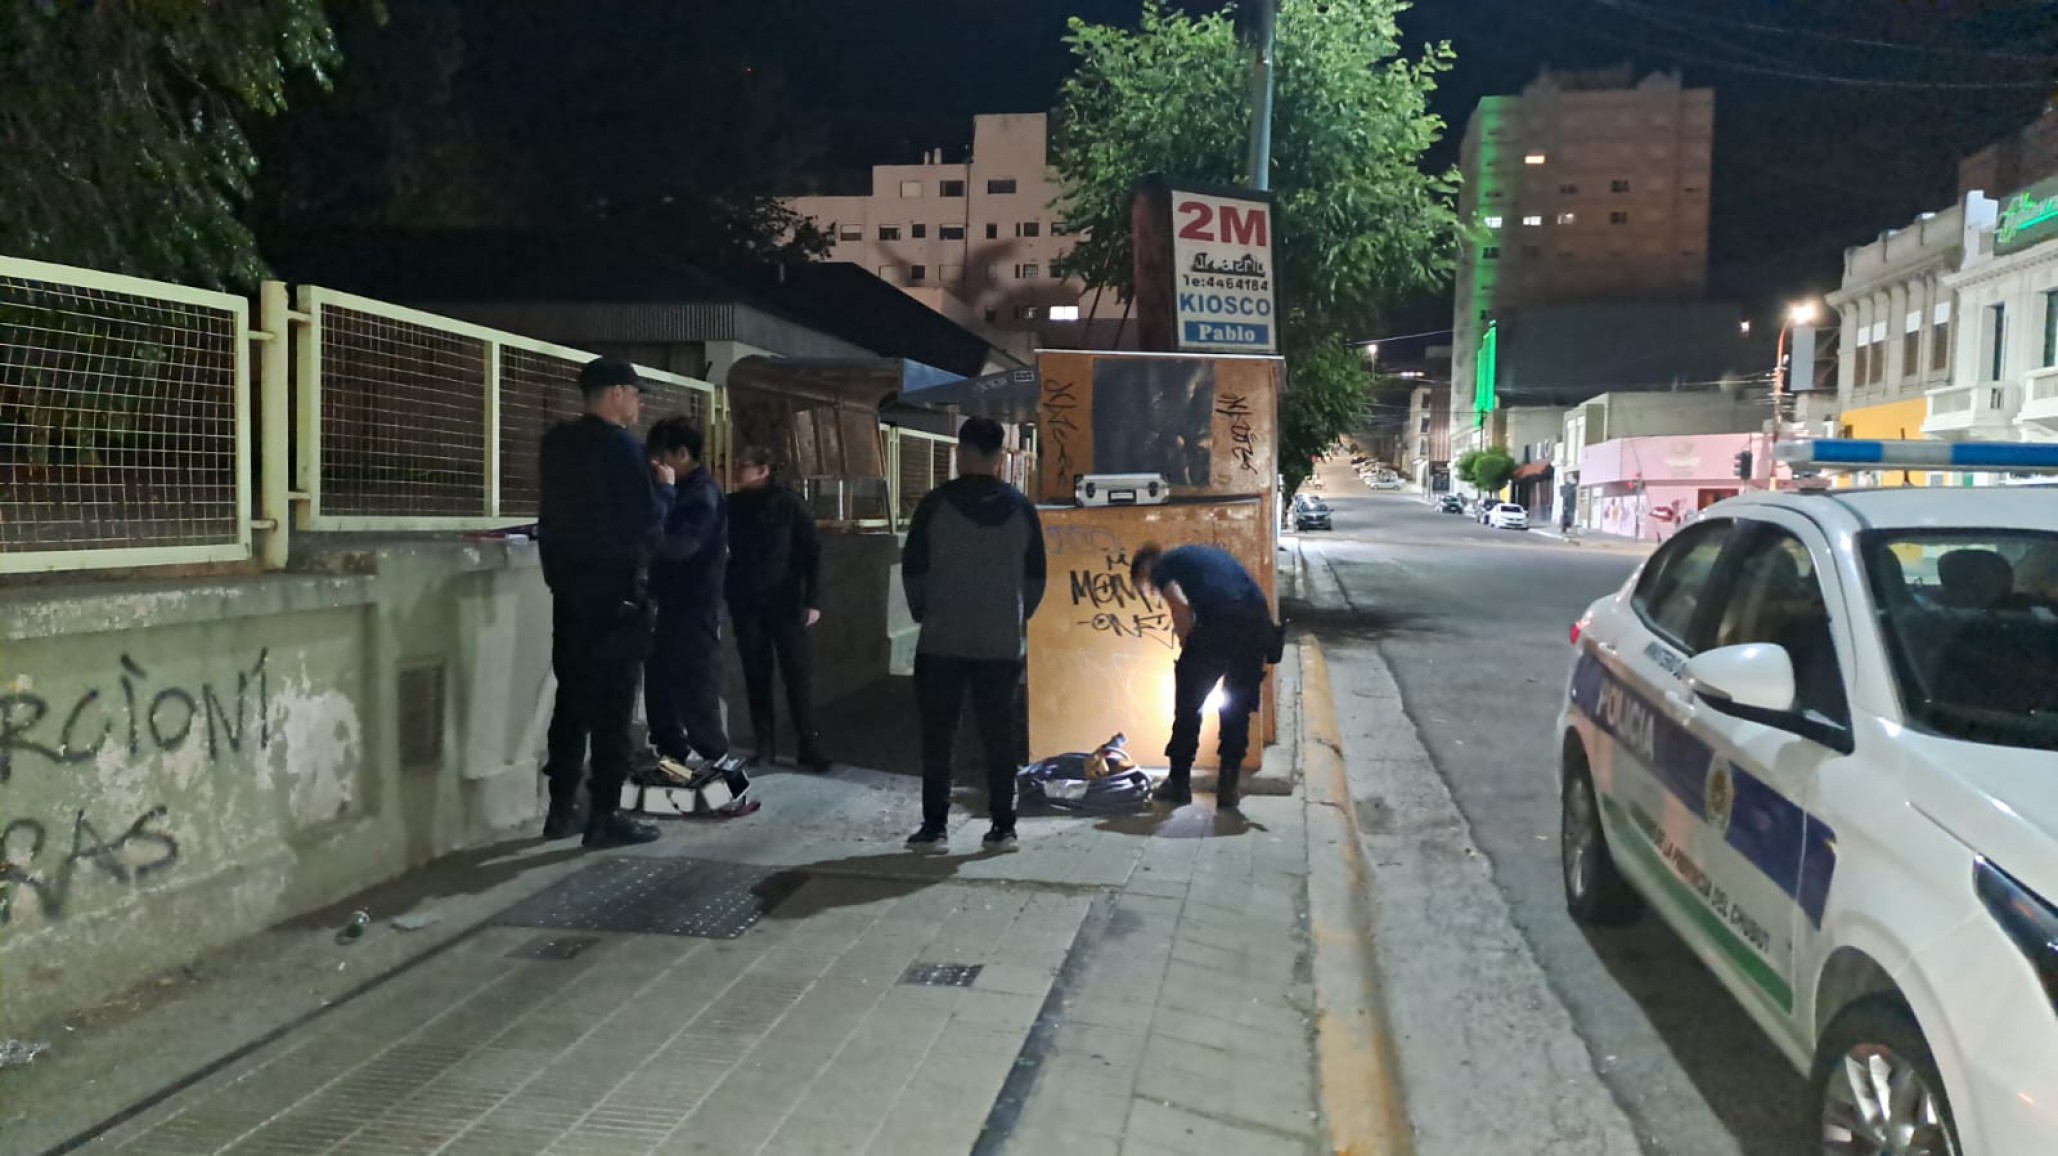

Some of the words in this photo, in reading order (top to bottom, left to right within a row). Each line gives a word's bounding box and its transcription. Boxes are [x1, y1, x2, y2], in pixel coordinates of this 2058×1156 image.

[1178, 201, 1266, 247] 2M
[1180, 294, 1271, 316] KIOSCO
[1199, 324, 1256, 342] Pablo
